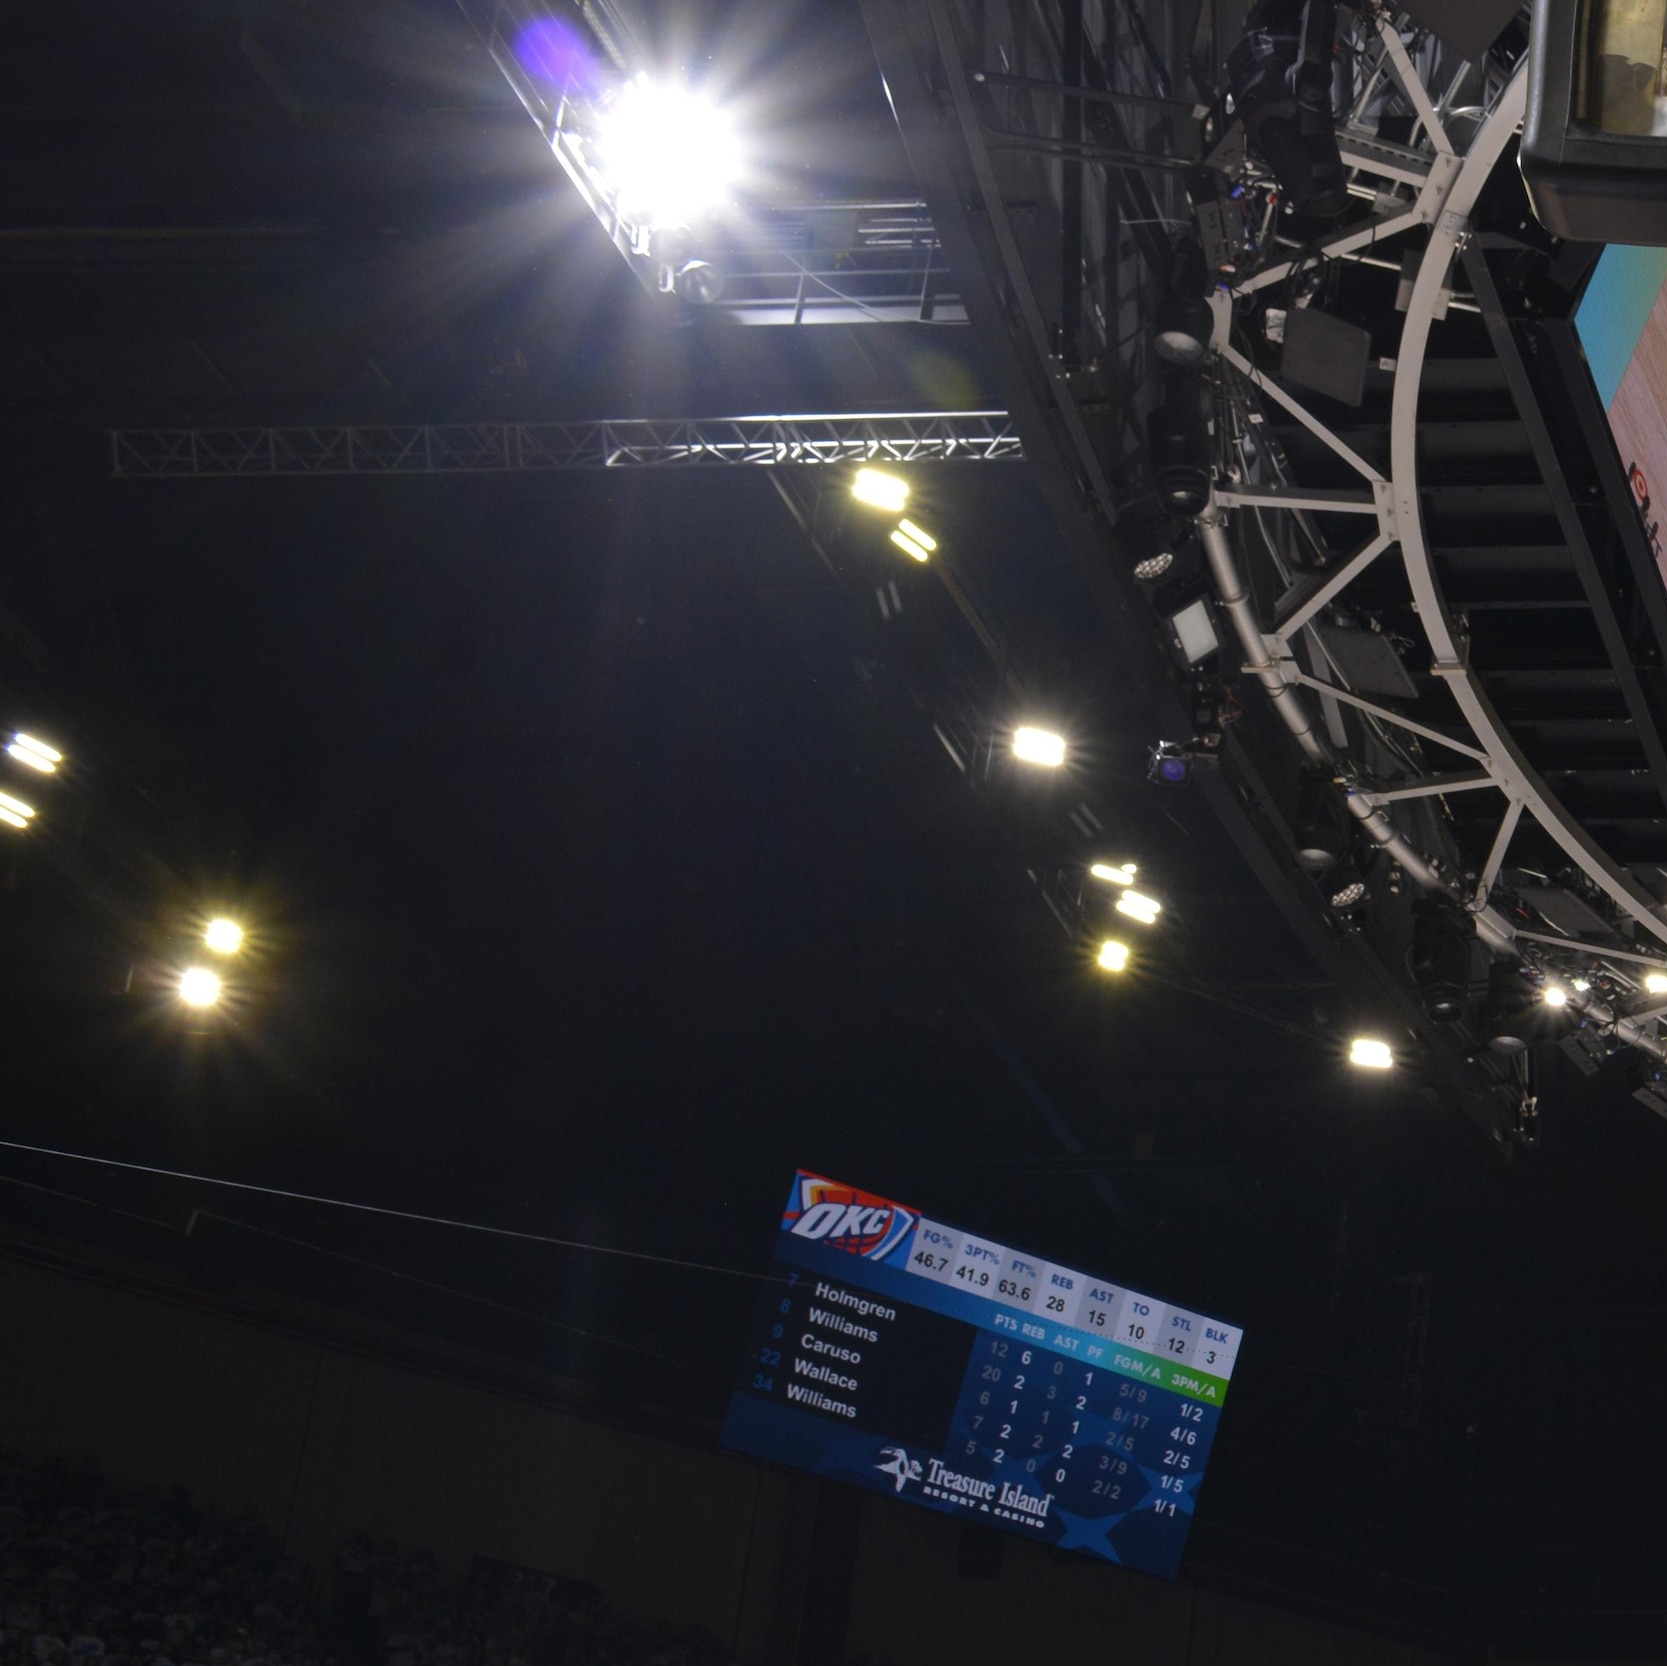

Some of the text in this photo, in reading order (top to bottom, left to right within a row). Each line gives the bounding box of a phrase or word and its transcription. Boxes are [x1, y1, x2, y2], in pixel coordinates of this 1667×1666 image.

[791, 1203, 891, 1239] OKC
[914, 1251, 1030, 1300] 46.7 41.9 63.6
[923, 1229, 1113, 1304] FG% 3PT% FT% REB AST
[815, 1282, 1203, 1422] Holmgren 1/2
[1022, 1322, 1079, 1351] REB AST
[801, 1334, 1190, 1469] Caruso 2/5
[809, 1307, 1197, 1445] Williams 4/6
[787, 1383, 1176, 1517] Williams 1/1
[795, 1358, 1184, 1493] Wallace 1/5
[923, 1486, 1045, 1528] RESORT CASINO
[927, 1459, 1050, 1516] Treasure Island
